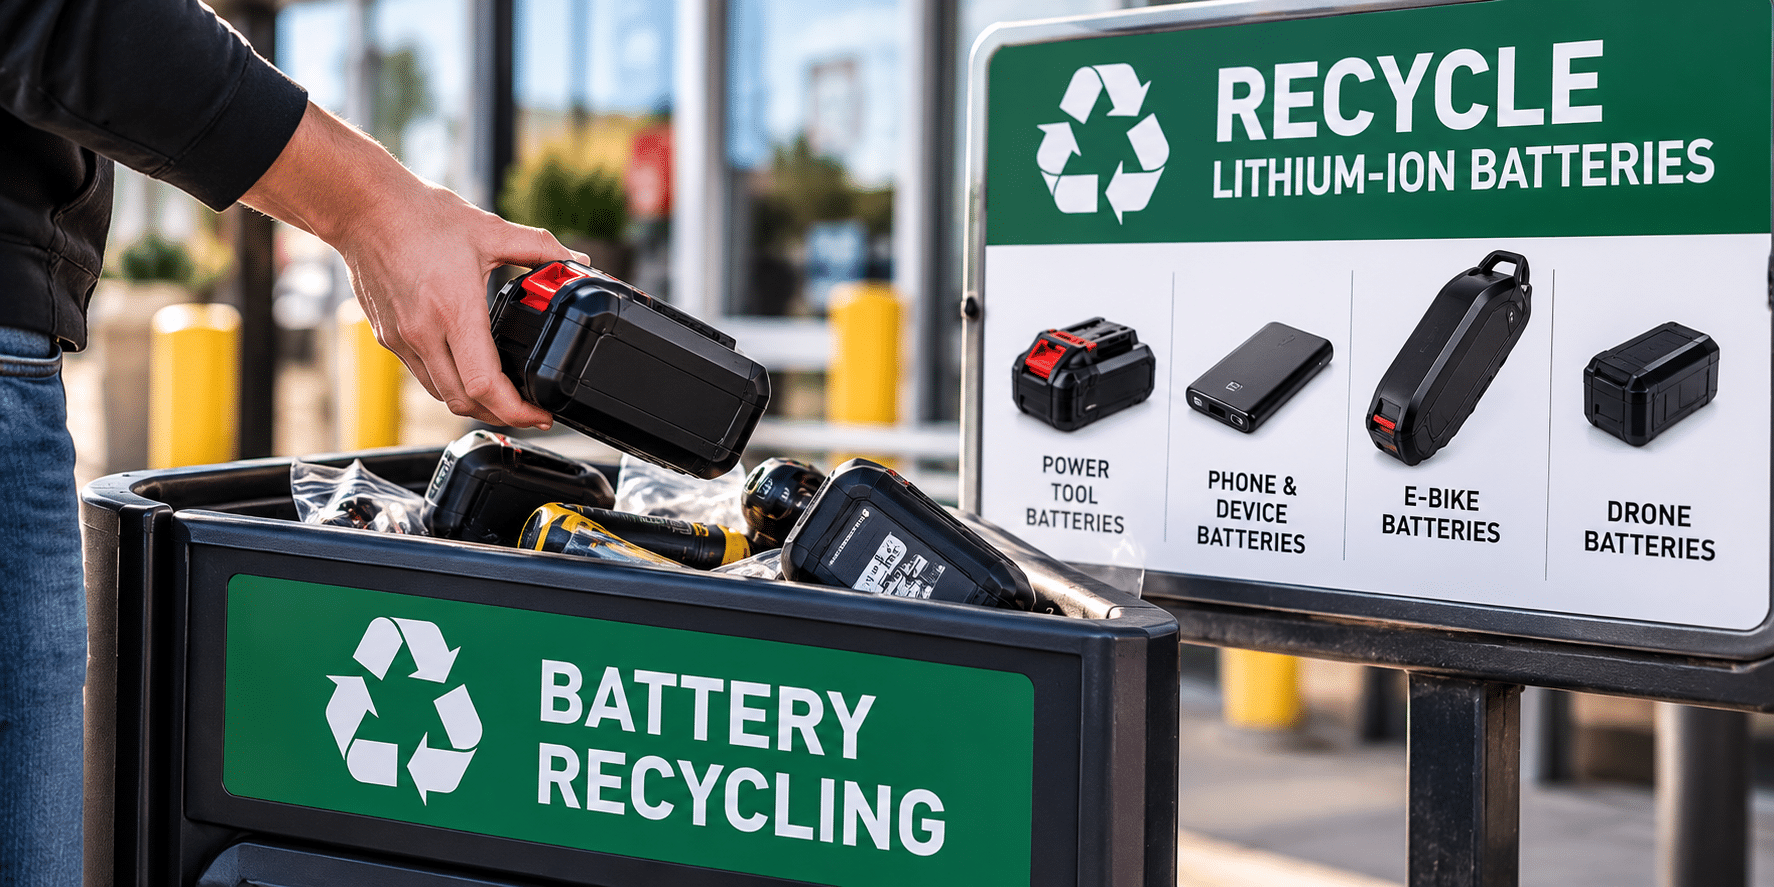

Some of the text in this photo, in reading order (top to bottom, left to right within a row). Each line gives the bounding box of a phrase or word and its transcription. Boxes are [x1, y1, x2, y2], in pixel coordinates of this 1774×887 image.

[1217, 40, 1604, 143] RECYCLE
[1213, 139, 1715, 199] LITHIUM-ION BATTERIES
[1043, 455, 1110, 479] POWER
[1051, 482, 1098, 505] TOOL
[1208, 470, 1297, 497] PHONE &
[1216, 498, 1288, 525] DEVICE
[1404, 485, 1480, 512] E-BIKE
[1026, 507, 1125, 535] BATTERIES
[1607, 500, 1692, 528] DRONE
[1197, 526, 1306, 554] BATTERIES
[1382, 513, 1501, 544] BATTERIES
[1584, 529, 1716, 562] BATTERIES
[540, 659, 876, 759] BATTERY
[537, 743, 946, 857] RECYCLING
